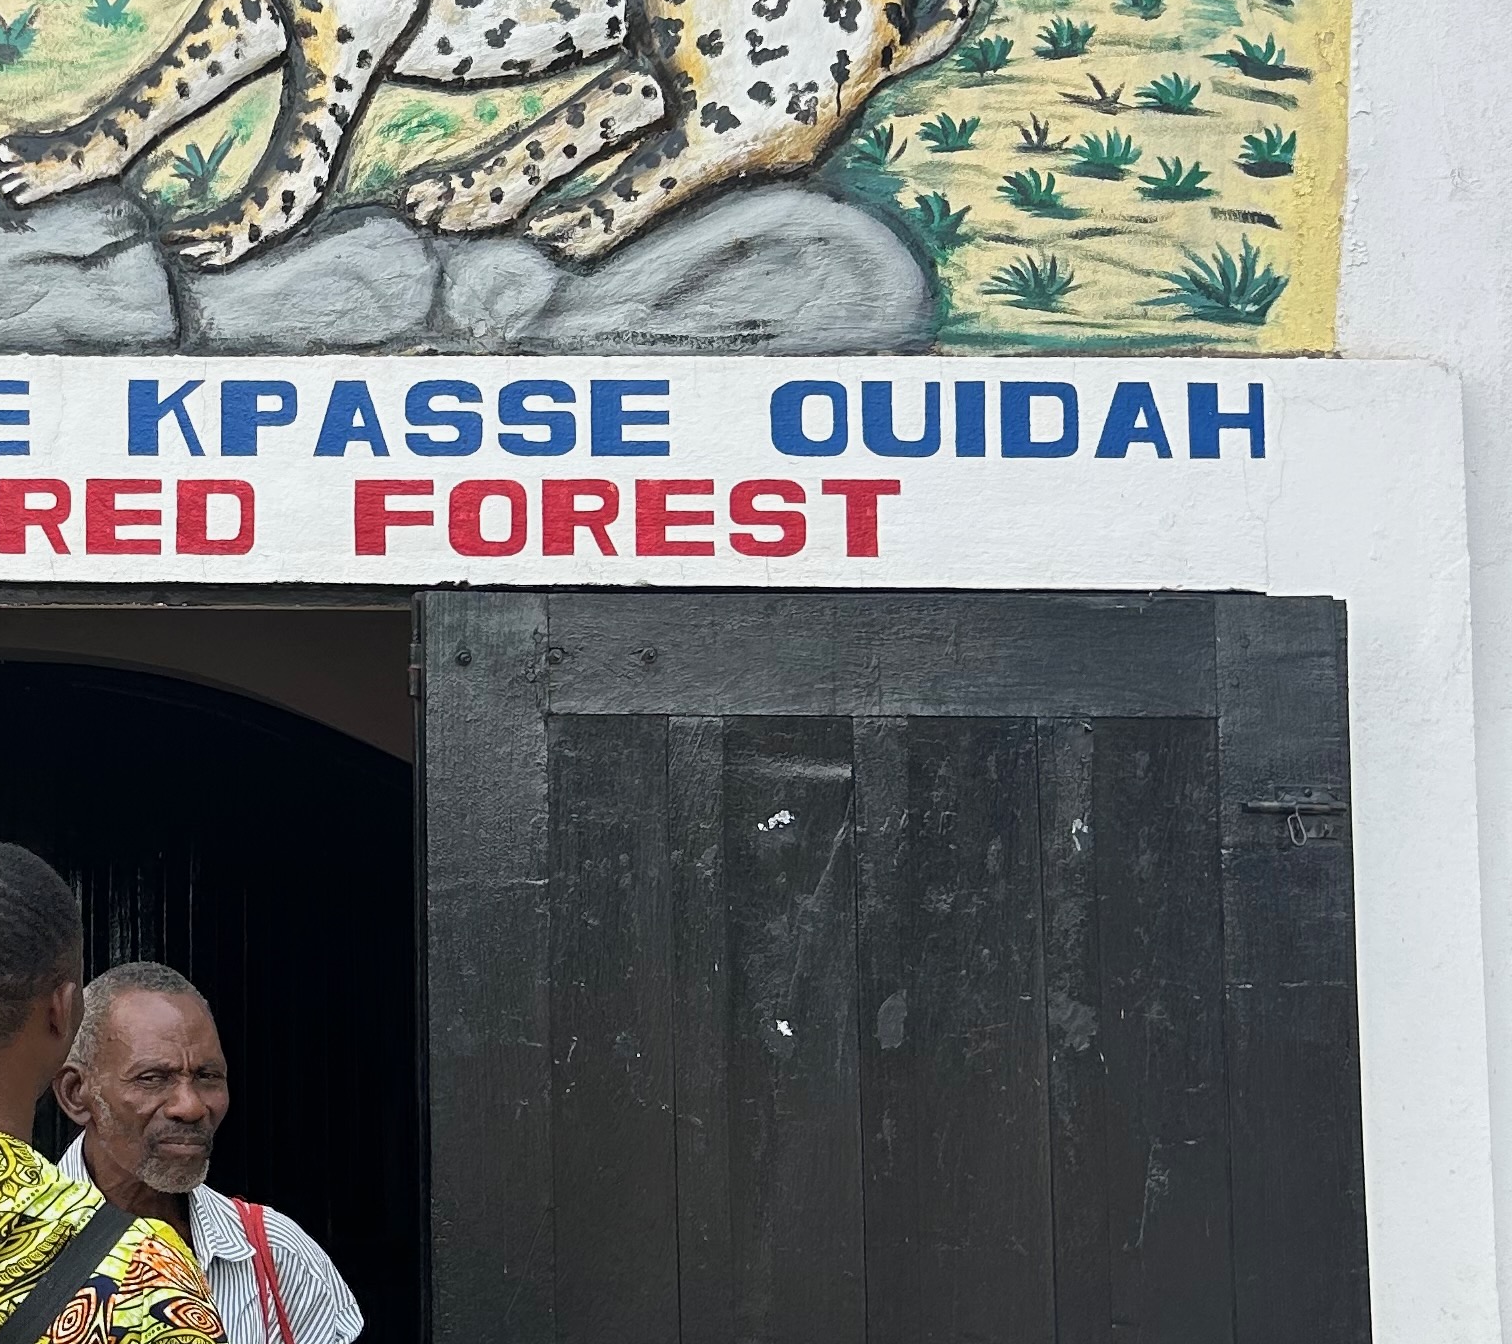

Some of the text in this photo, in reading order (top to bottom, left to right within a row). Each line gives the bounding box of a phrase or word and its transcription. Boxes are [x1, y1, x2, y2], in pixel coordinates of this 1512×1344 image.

[128, 379, 672, 458] KPASSE
[770, 380, 1266, 459] OUIDAH
[354, 478, 902, 558] FOREST
